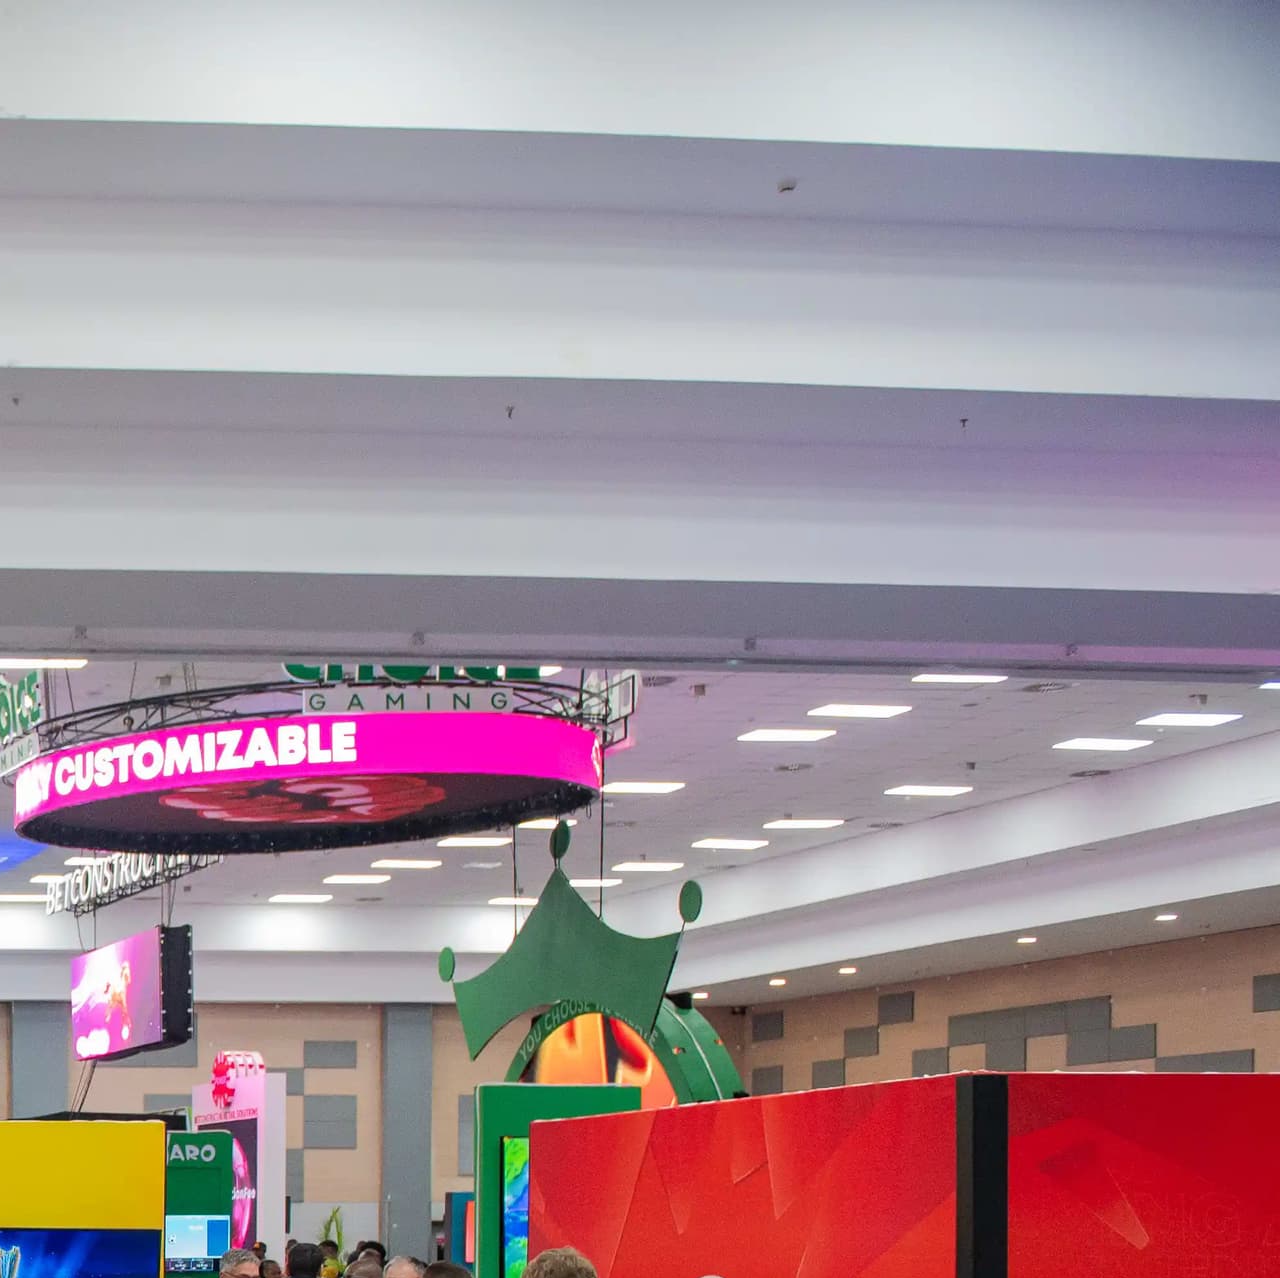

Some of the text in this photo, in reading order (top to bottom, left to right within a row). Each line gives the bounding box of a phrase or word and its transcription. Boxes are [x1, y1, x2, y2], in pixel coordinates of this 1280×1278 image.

[309, 693, 508, 711] GAMING
[54, 721, 357, 796] CUSTOMIZABLE
[519, 1028, 542, 1062] YOU
